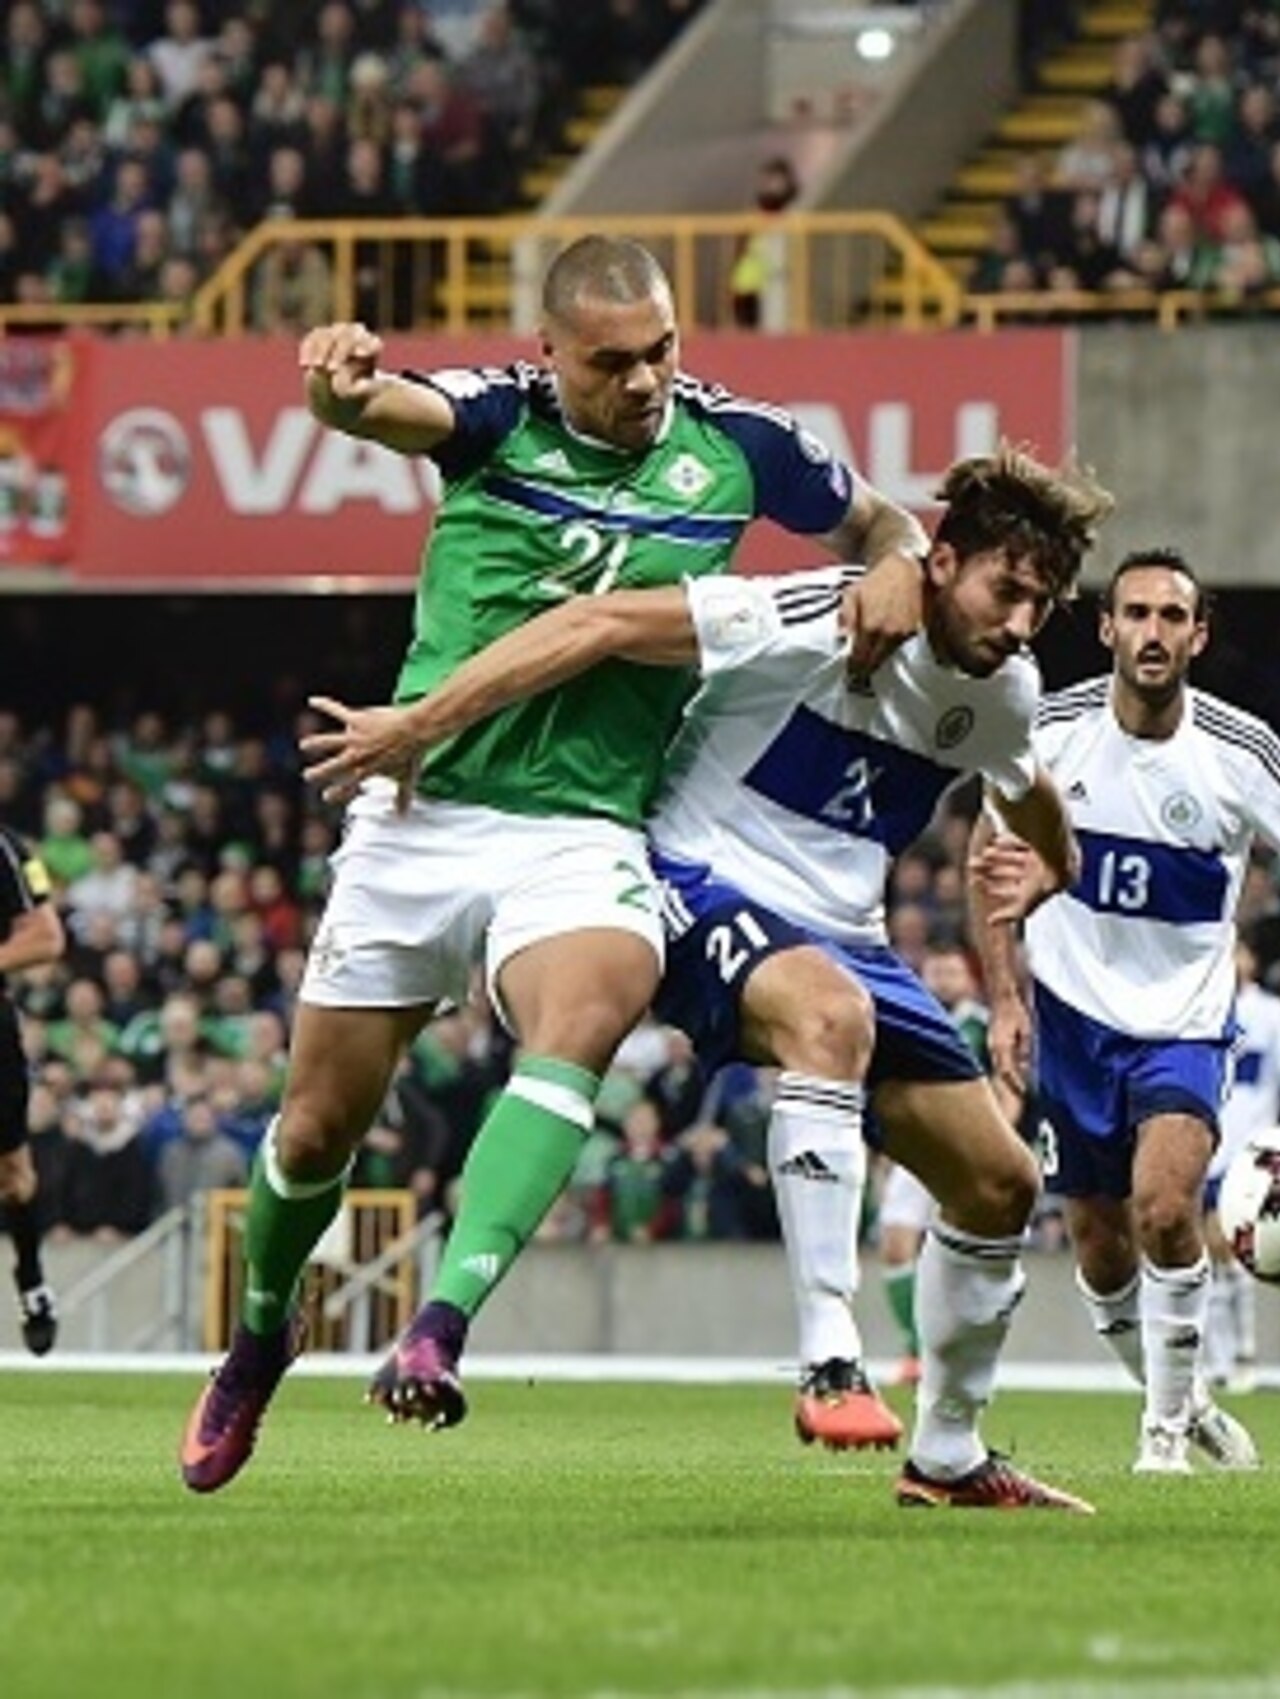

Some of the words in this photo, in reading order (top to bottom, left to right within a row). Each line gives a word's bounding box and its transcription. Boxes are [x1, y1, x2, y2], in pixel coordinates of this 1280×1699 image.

[535, 520, 633, 598] 21
[1098, 850, 1151, 909] 13
[705, 909, 771, 974] 21
